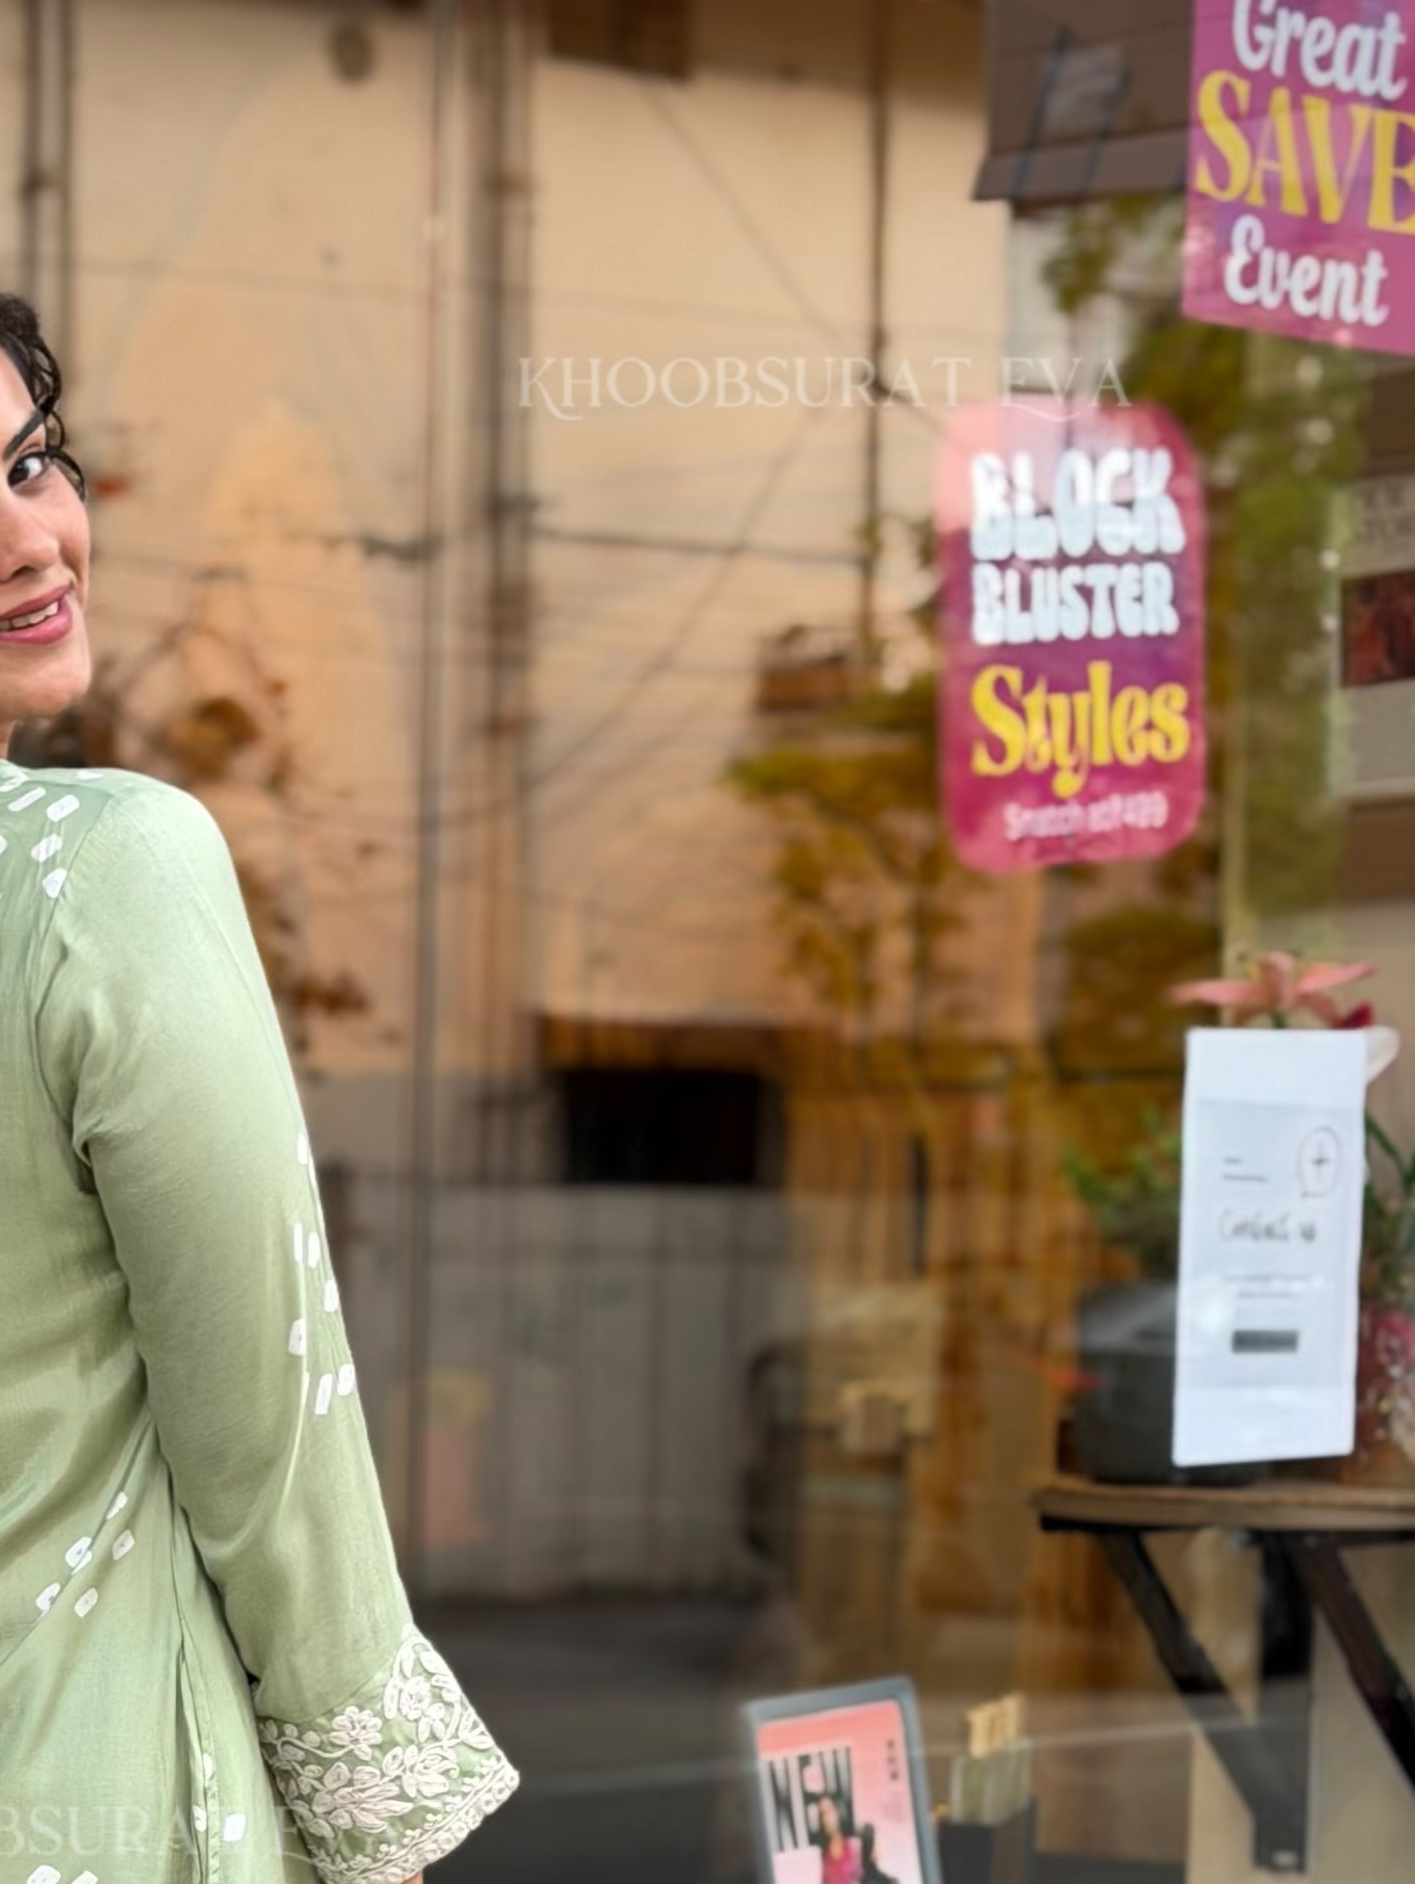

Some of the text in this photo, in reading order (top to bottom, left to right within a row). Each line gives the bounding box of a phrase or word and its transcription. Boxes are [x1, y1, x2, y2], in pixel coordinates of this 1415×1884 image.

[1232, 0, 1408, 100] Great
[1195, 69, 1415, 236] SAVE
[1223, 214, 1389, 327] Event
[971, 447, 1187, 562] BLOCK
[972, 562, 1180, 645] BLUSTER
[971, 659, 1190, 799] Styles
[761, 1744, 856, 1853] NEW
